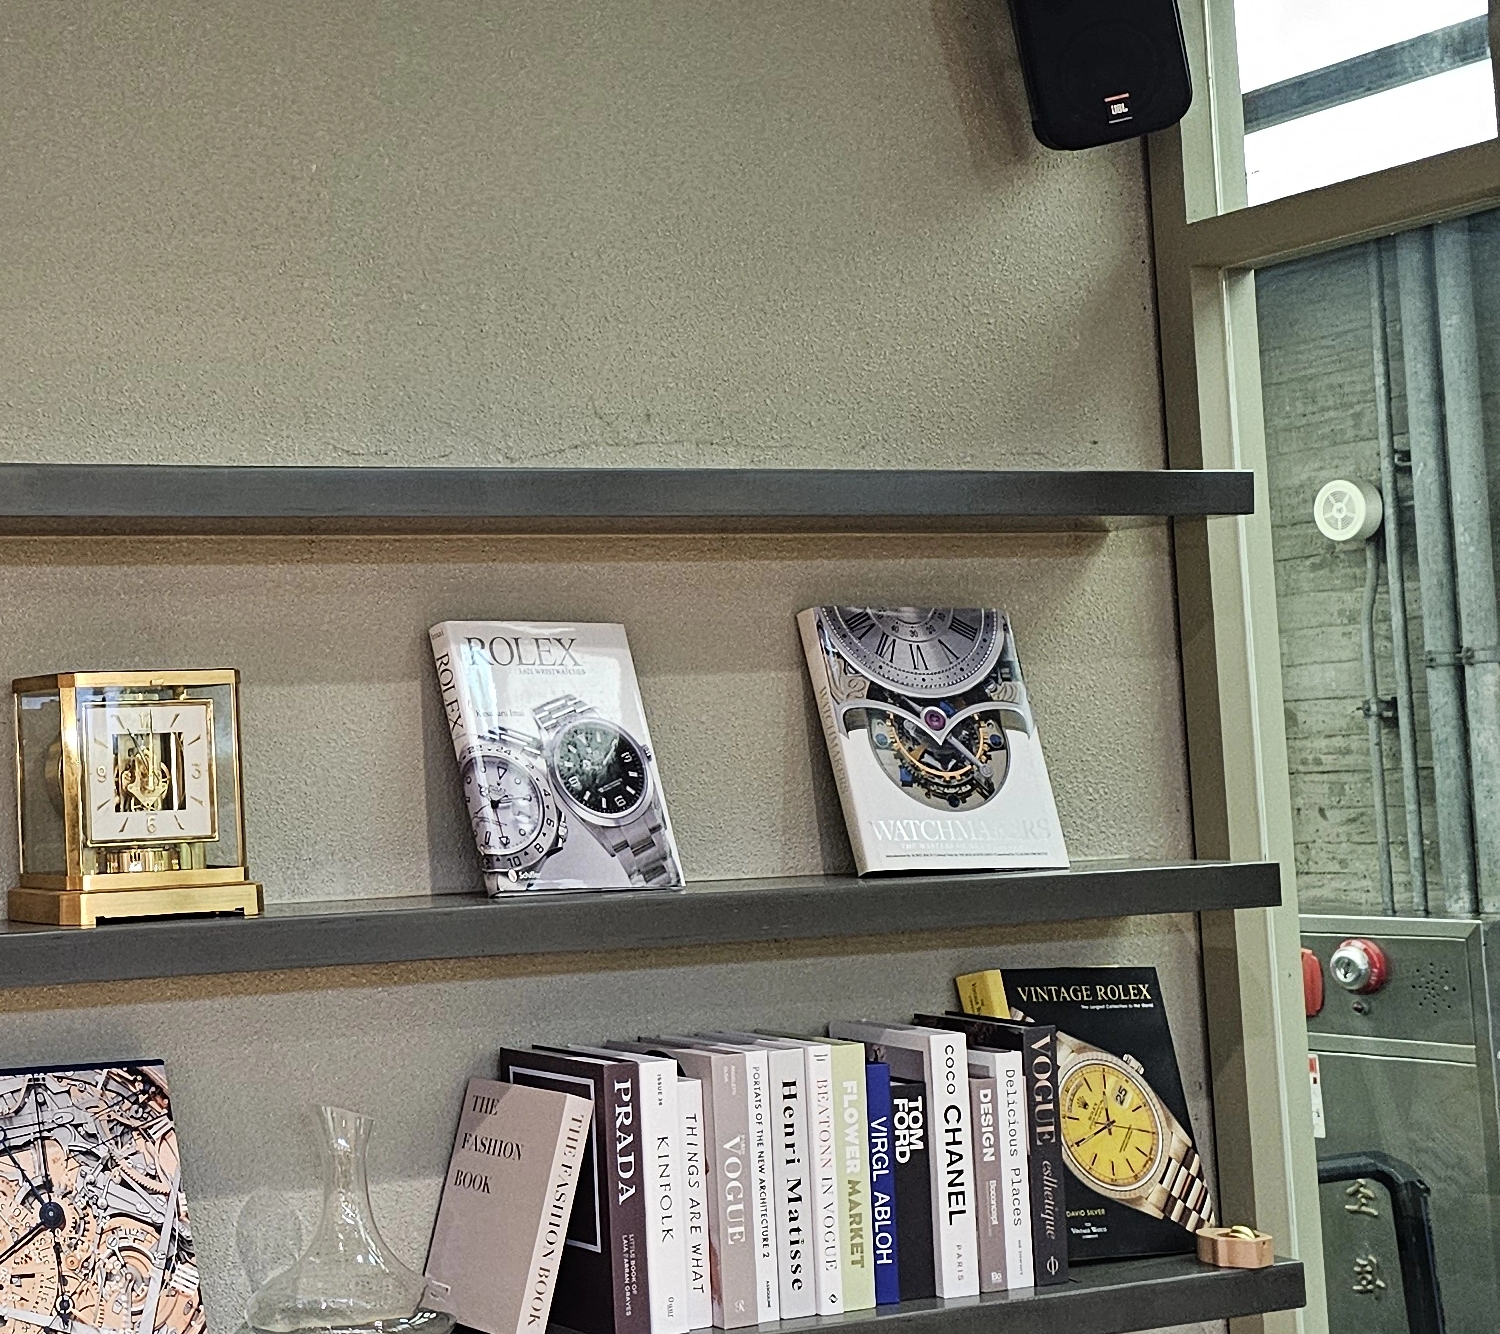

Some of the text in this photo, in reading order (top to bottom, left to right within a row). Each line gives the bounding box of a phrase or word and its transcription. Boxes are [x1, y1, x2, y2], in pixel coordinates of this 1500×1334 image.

[1110, 102, 1129, 115] JBL
[463, 636, 583, 666] ROLEX
[436, 651, 463, 732] ROLEX
[96, 766, 107, 783] 9
[869, 818, 1051, 841] WATCHMAKRS
[1017, 984, 1152, 1002] VINTAGE ROLEX
[472, 1095, 500, 1116] THE
[755, 1112, 764, 1126] OF
[1030, 1035, 1057, 1146] VOGUE
[1115, 1085, 1128, 1106] 25
[461, 1132, 524, 1161] FASHION
[614, 1078, 636, 1206] PRADA
[756, 1129, 765, 1147] THE
[893, 1098, 911, 1164] FORD
[908, 1095, 925, 1150] TOM
[944, 1044, 967, 1226] COCO CHANEL
[979, 1089, 995, 1163] DESIGN
[1005, 1069, 1023, 1227] Delicious Places
[454, 1169, 492, 1195] BOOK
[657, 1135, 675, 1243] KINFOLK
[722, 1135, 745, 1246] VOGUE
[757, 1151, 766, 1174] NEW
[781, 1078, 805, 1291] Henri Matisse
[821, 1177, 834, 1195] IN
[842, 1080, 865, 1269] FLOWER MARKET
[870, 1116, 893, 1265] VIRGL ABLOH
[527, 1115, 584, 1327] THE FASHION BOOK
[685, 1113, 705, 1294] THINGS ARE WHAT
[758, 1178, 770, 1249] ARCHITECTURE
[823, 1202, 838, 1272] VOGUE
[955, 1244, 964, 1282] PARIS
[631, 1284, 638, 1295] OF
